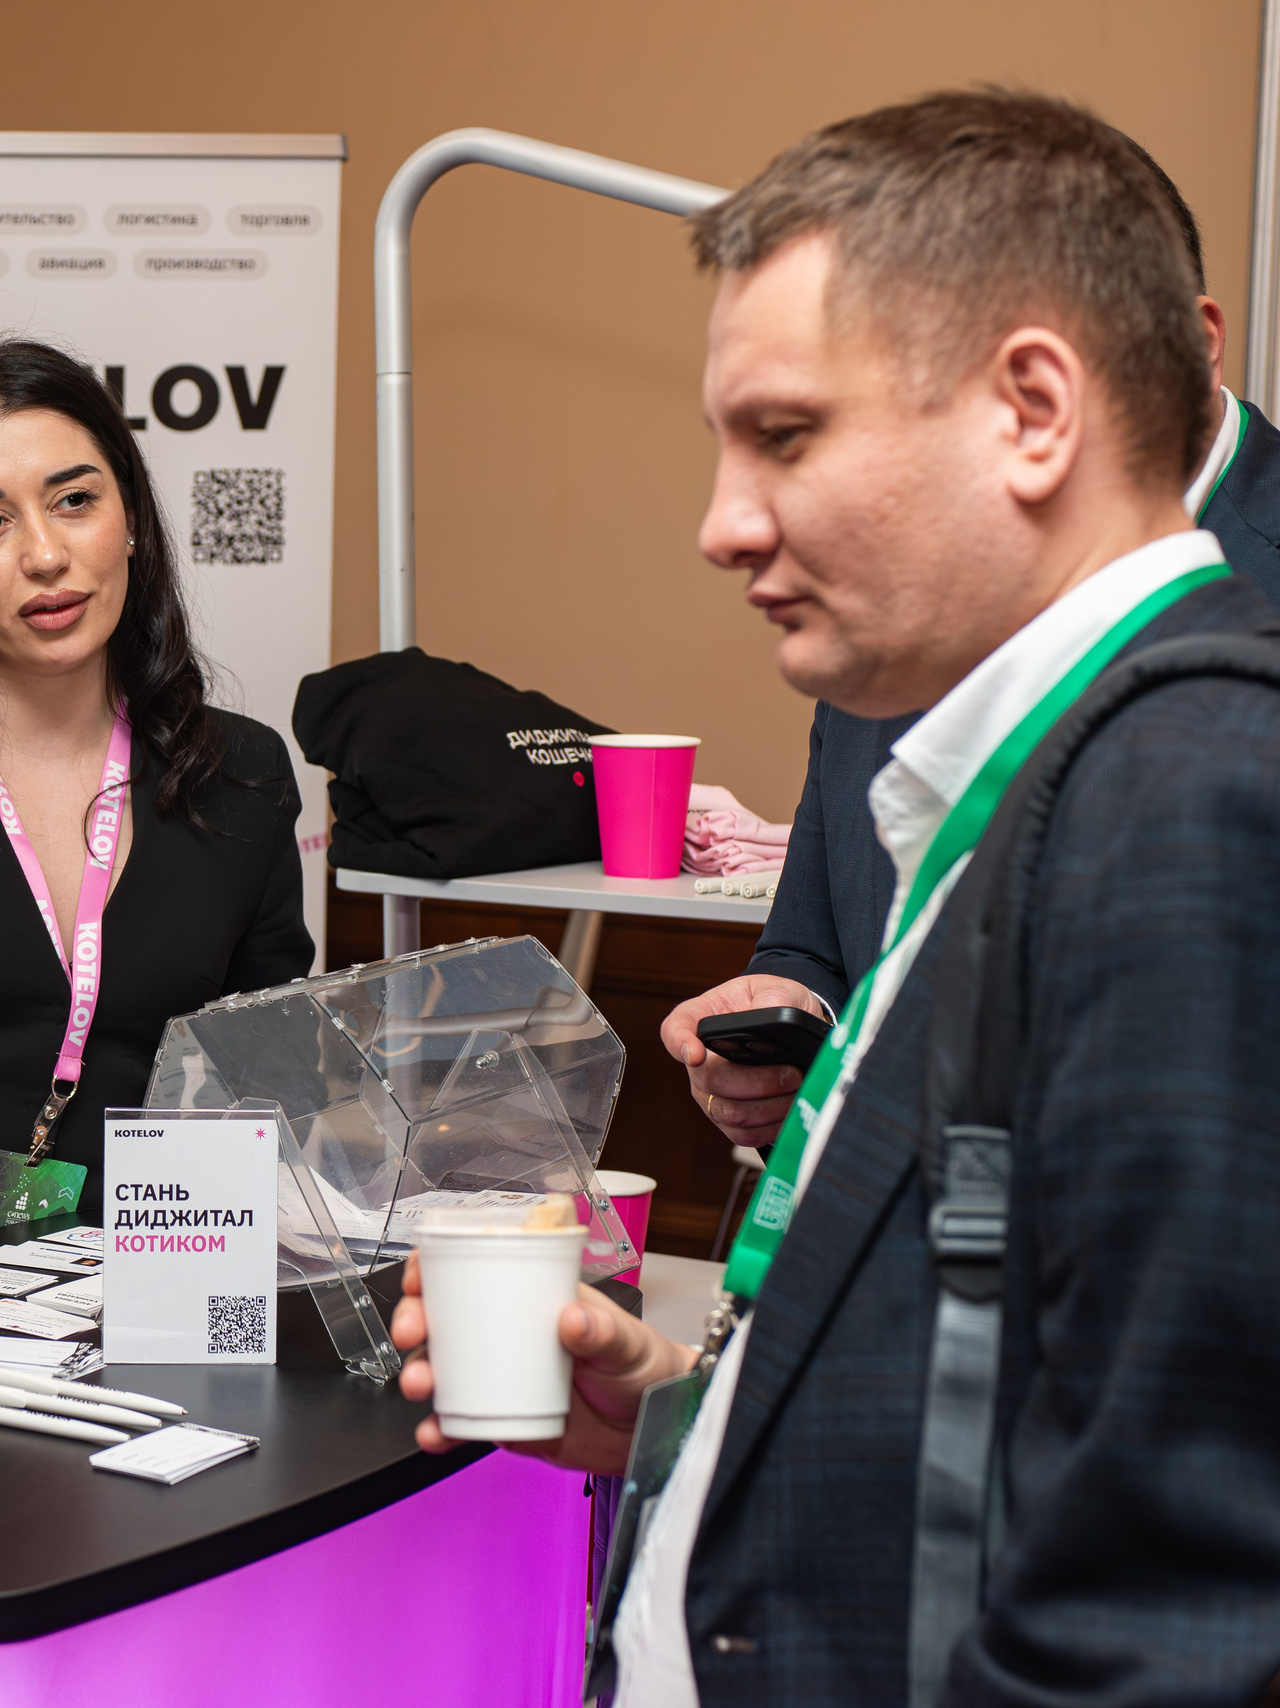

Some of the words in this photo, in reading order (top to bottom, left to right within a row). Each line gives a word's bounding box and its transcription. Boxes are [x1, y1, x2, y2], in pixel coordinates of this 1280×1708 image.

[116, 212, 198, 227] логистика
[239, 213, 311, 230] торговля
[38, 257, 105, 272] авиация
[145, 257, 257, 273] производство
[89, 759, 126, 870] KOTELOV
[68, 922, 98, 1047] KOTELOV
[114, 1129, 165, 1138] KOTELOV
[114, 1183, 190, 1202] СТАНЬ
[114, 1209, 254, 1230] ДИДЖИТАЛ
[114, 1235, 226, 1253] КОТИКОМ
